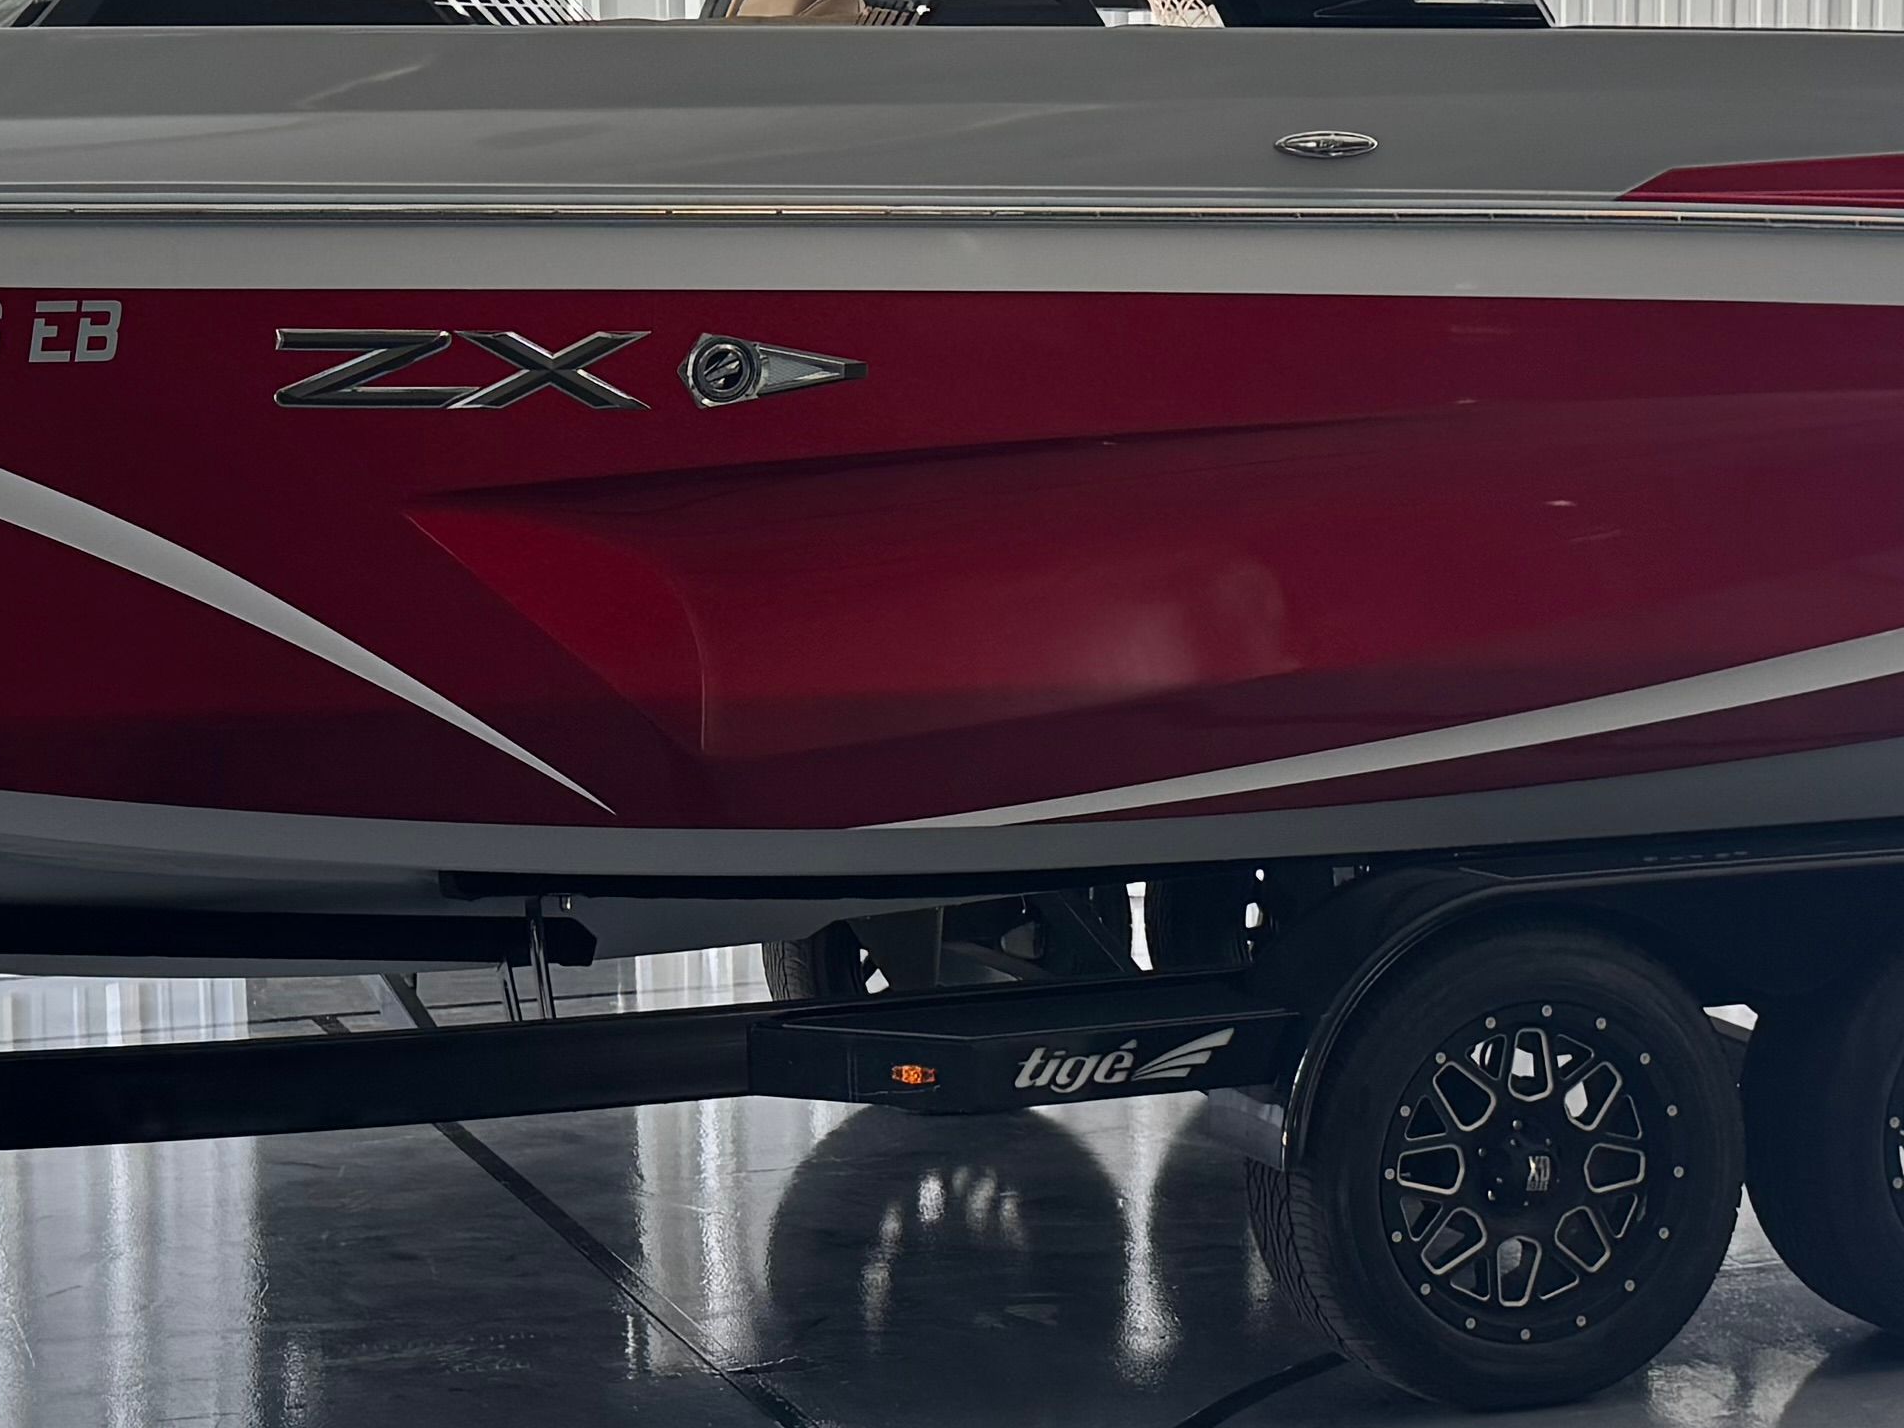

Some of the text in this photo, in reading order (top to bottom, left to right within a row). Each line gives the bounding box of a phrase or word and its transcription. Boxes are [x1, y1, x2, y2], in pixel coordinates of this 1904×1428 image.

[29, 300, 123, 364] EB
[274, 328, 652, 410] ZX
[1015, 1039, 1138, 1094] tigé
